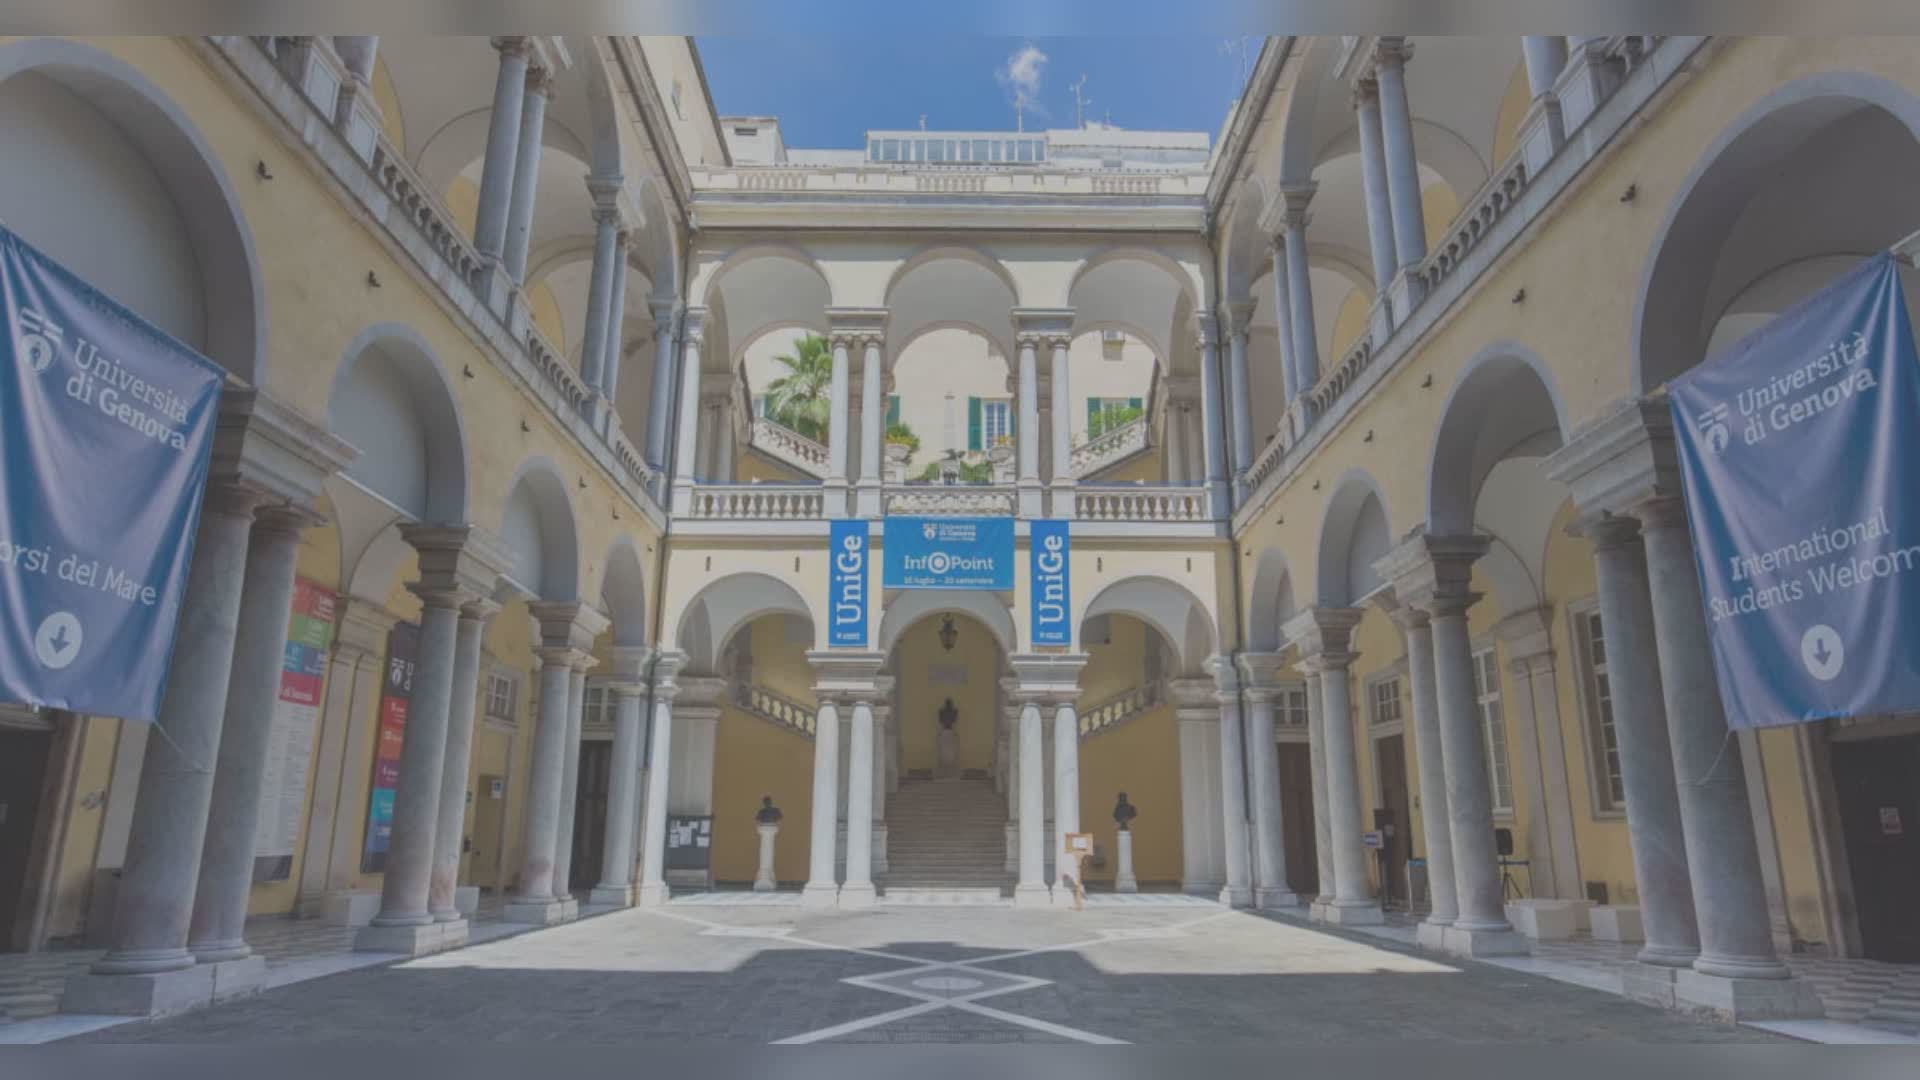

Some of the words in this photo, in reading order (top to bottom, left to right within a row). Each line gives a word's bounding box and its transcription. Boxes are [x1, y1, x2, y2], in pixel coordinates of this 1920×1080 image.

[66, 371, 93, 405] di
[99, 388, 186, 450] Genova
[75, 338, 188, 425] Università
[1736, 331, 1869, 417] Università
[1744, 414, 1767, 446] di
[1770, 368, 1877, 430] Genova
[58, 554, 98, 587] del
[101, 566, 156, 605] Mare
[836, 535, 862, 626] UniGe
[1038, 535, 1064, 625] UniGe
[1729, 508, 1890, 581] International
[1710, 578, 1804, 622] Students
